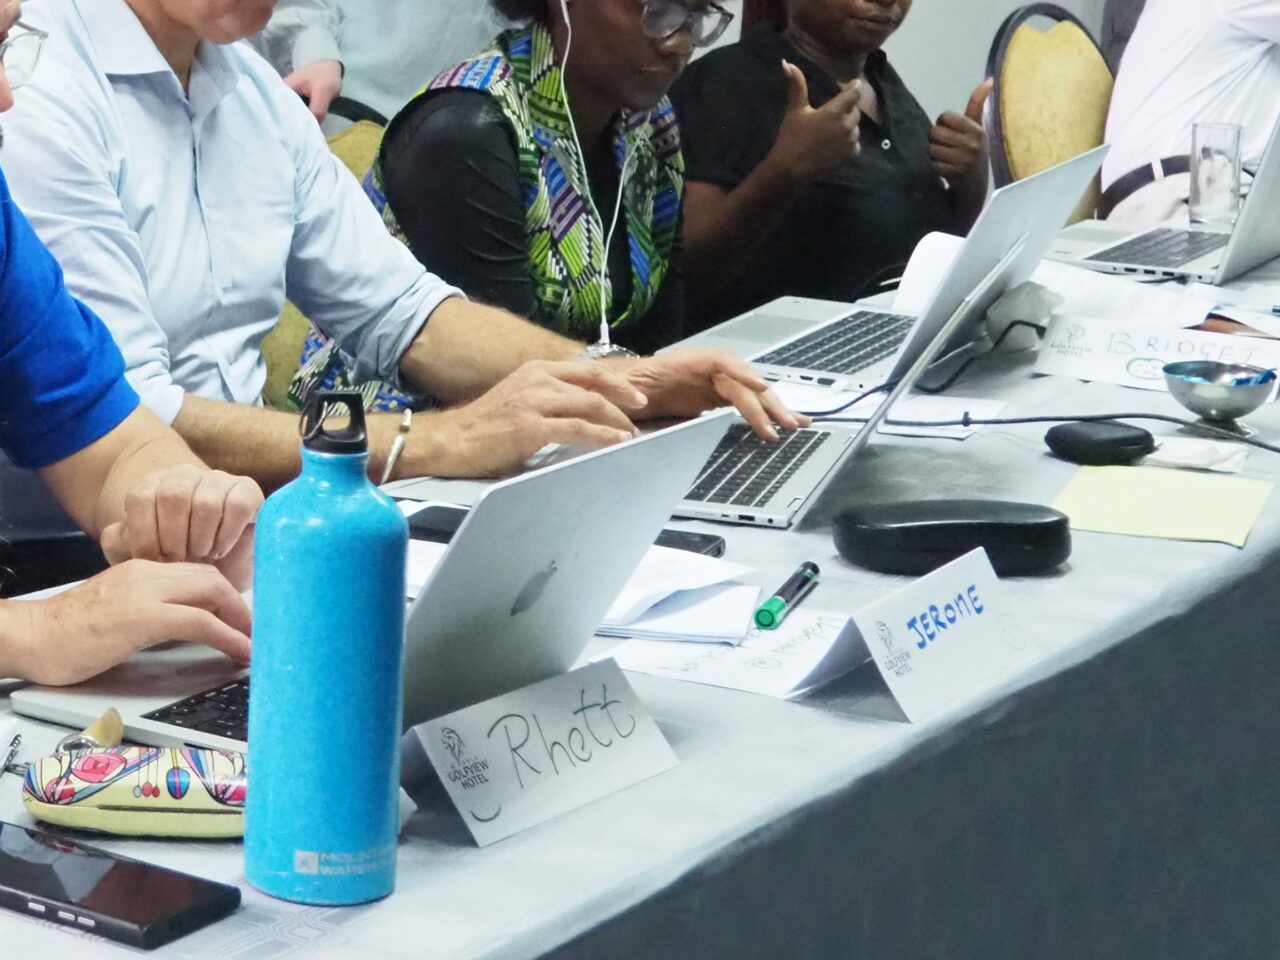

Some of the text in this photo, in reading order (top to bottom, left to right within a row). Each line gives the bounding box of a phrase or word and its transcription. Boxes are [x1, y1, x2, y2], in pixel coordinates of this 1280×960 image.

[1107, 331, 1260, 364] BRIDGET
[487, 682, 637, 790] Rhett
[448, 759, 489, 783] GOLFVIEW
[460, 773, 490, 791] HOTEL
